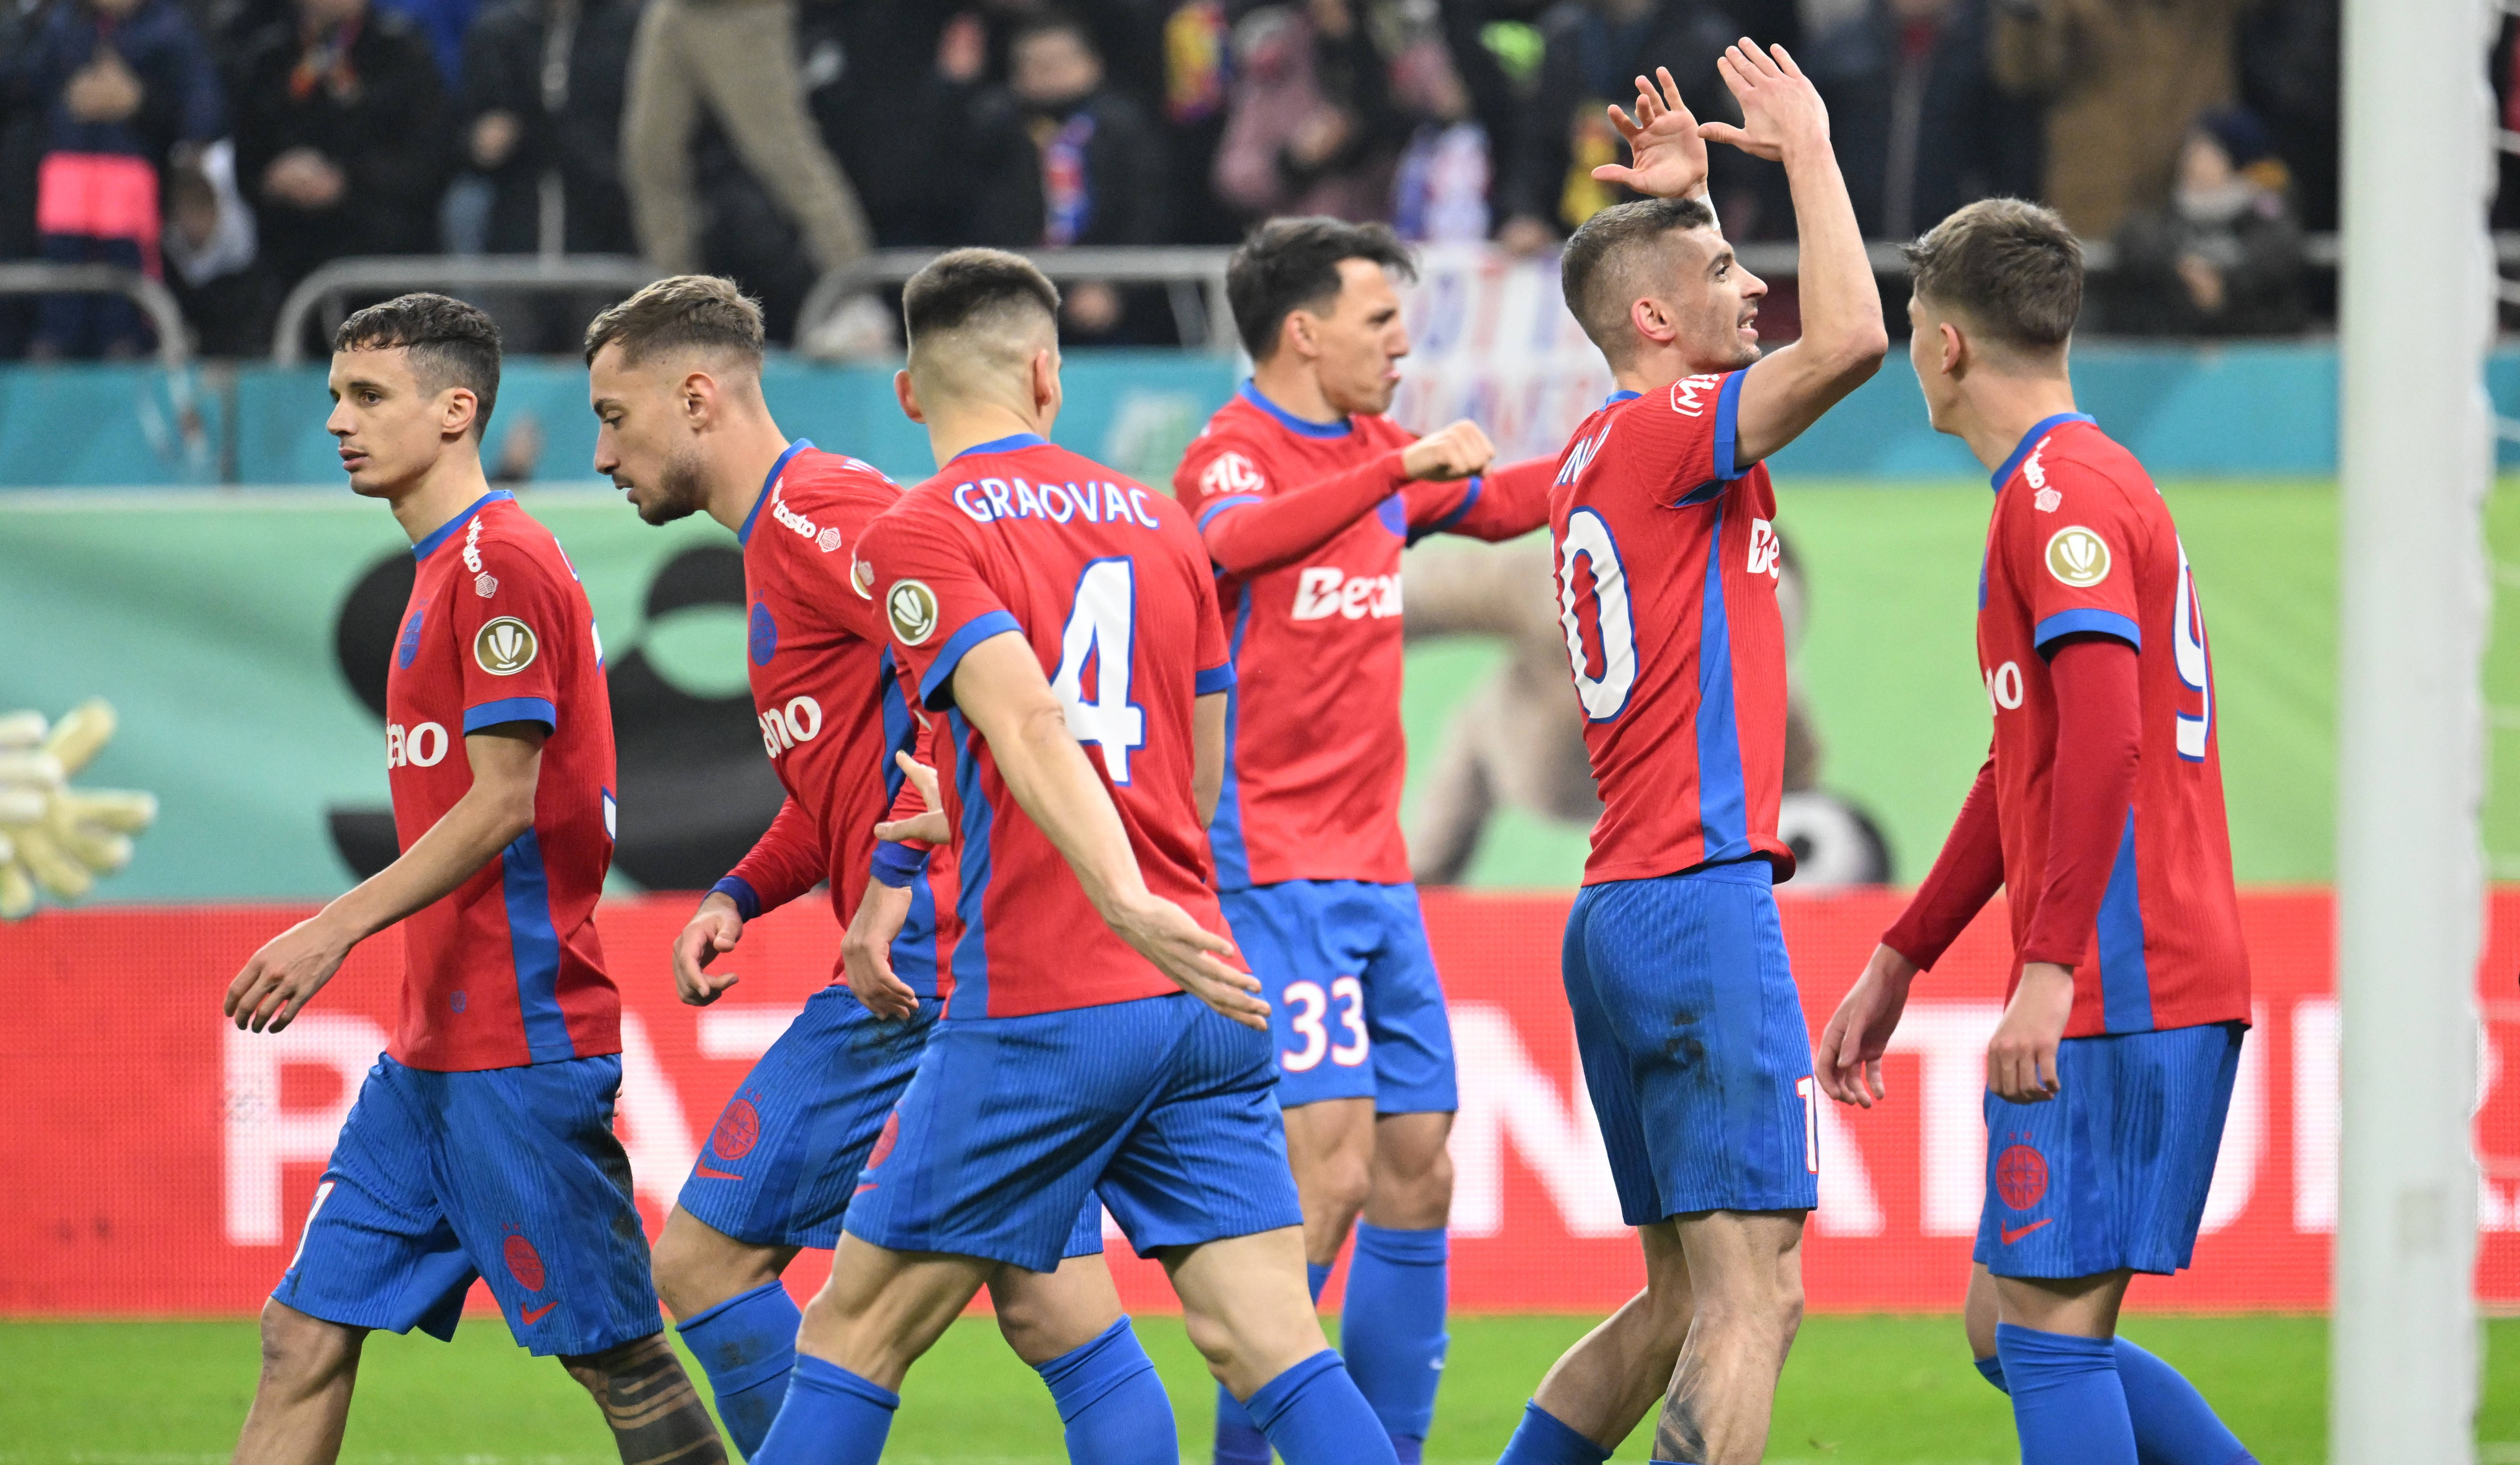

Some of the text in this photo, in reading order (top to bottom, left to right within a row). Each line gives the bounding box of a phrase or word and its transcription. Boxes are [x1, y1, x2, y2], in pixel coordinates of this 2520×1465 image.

[953, 477, 1160, 530] GRAOVAC
[1049, 555, 1147, 788] 4
[1550, 505, 1639, 724] 0
[2171, 529, 2212, 763] 9
[1281, 974, 1370, 1073] 33
[1795, 1074, 1819, 1174] 1
